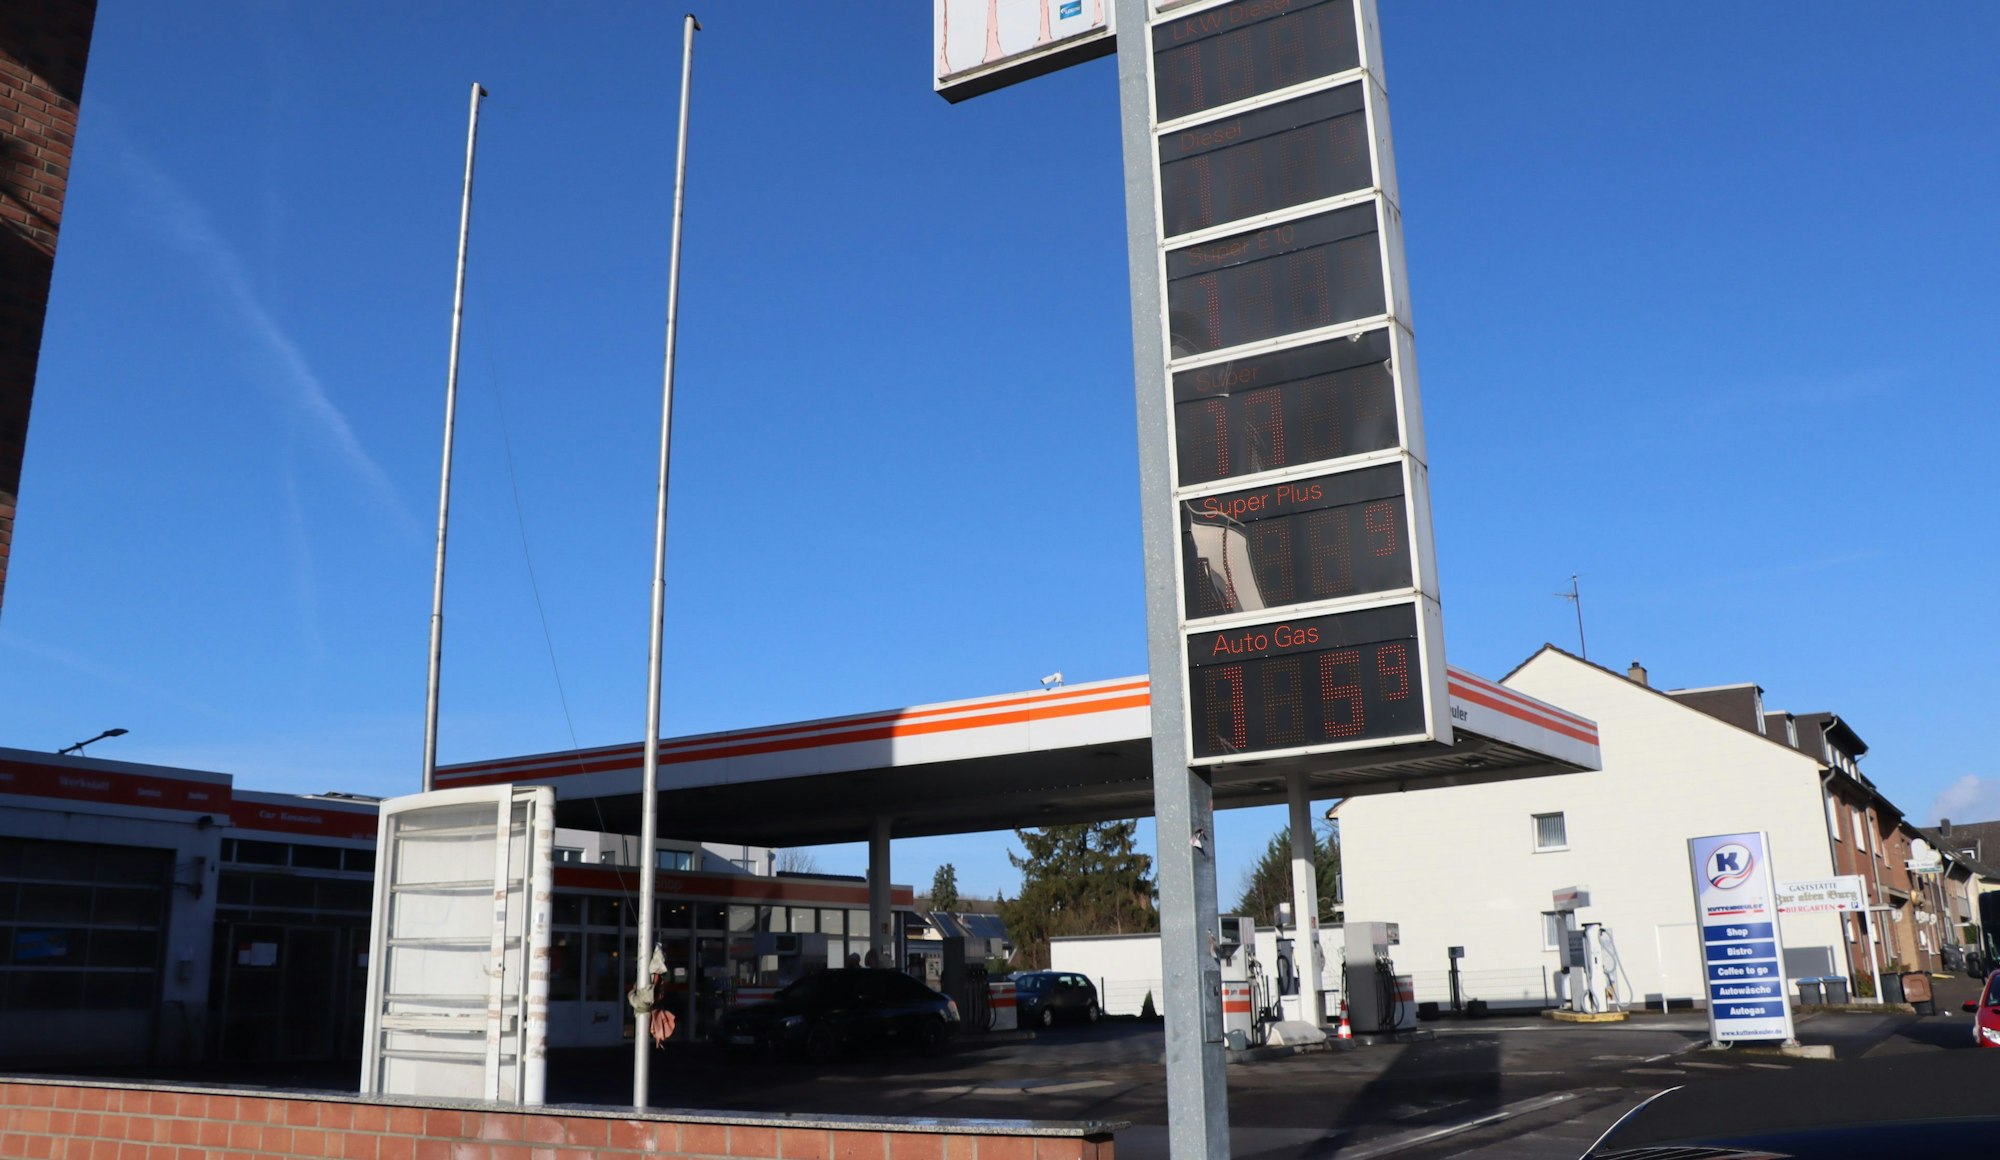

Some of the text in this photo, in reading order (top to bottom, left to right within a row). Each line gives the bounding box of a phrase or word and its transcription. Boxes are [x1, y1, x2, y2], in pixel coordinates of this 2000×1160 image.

[1171, 0, 1291, 41] LKW Diesel
[1180, 121, 1242, 151] Diesel
[1188, 240, 1250, 268] Super
[1195, 366, 1260, 393] Super
[1202, 484, 1323, 519] Super Plus
[1213, 625, 1320, 657] Auto Gas
[1450, 705, 1468, 721] uler
[1716, 852, 1740, 872] K
[1798, 892, 1824, 901] alten
[1827, 890, 1858, 902] Burg
[1786, 904, 1836, 914] BIERGARTEN
[1726, 928, 1748, 938] Shop
[1727, 947, 1753, 957] Bistro
[1718, 966, 1769, 976] Coffee to go
[1719, 986, 1772, 996] Autowäsche
[1730, 1006, 1766, 1016] Autogas
